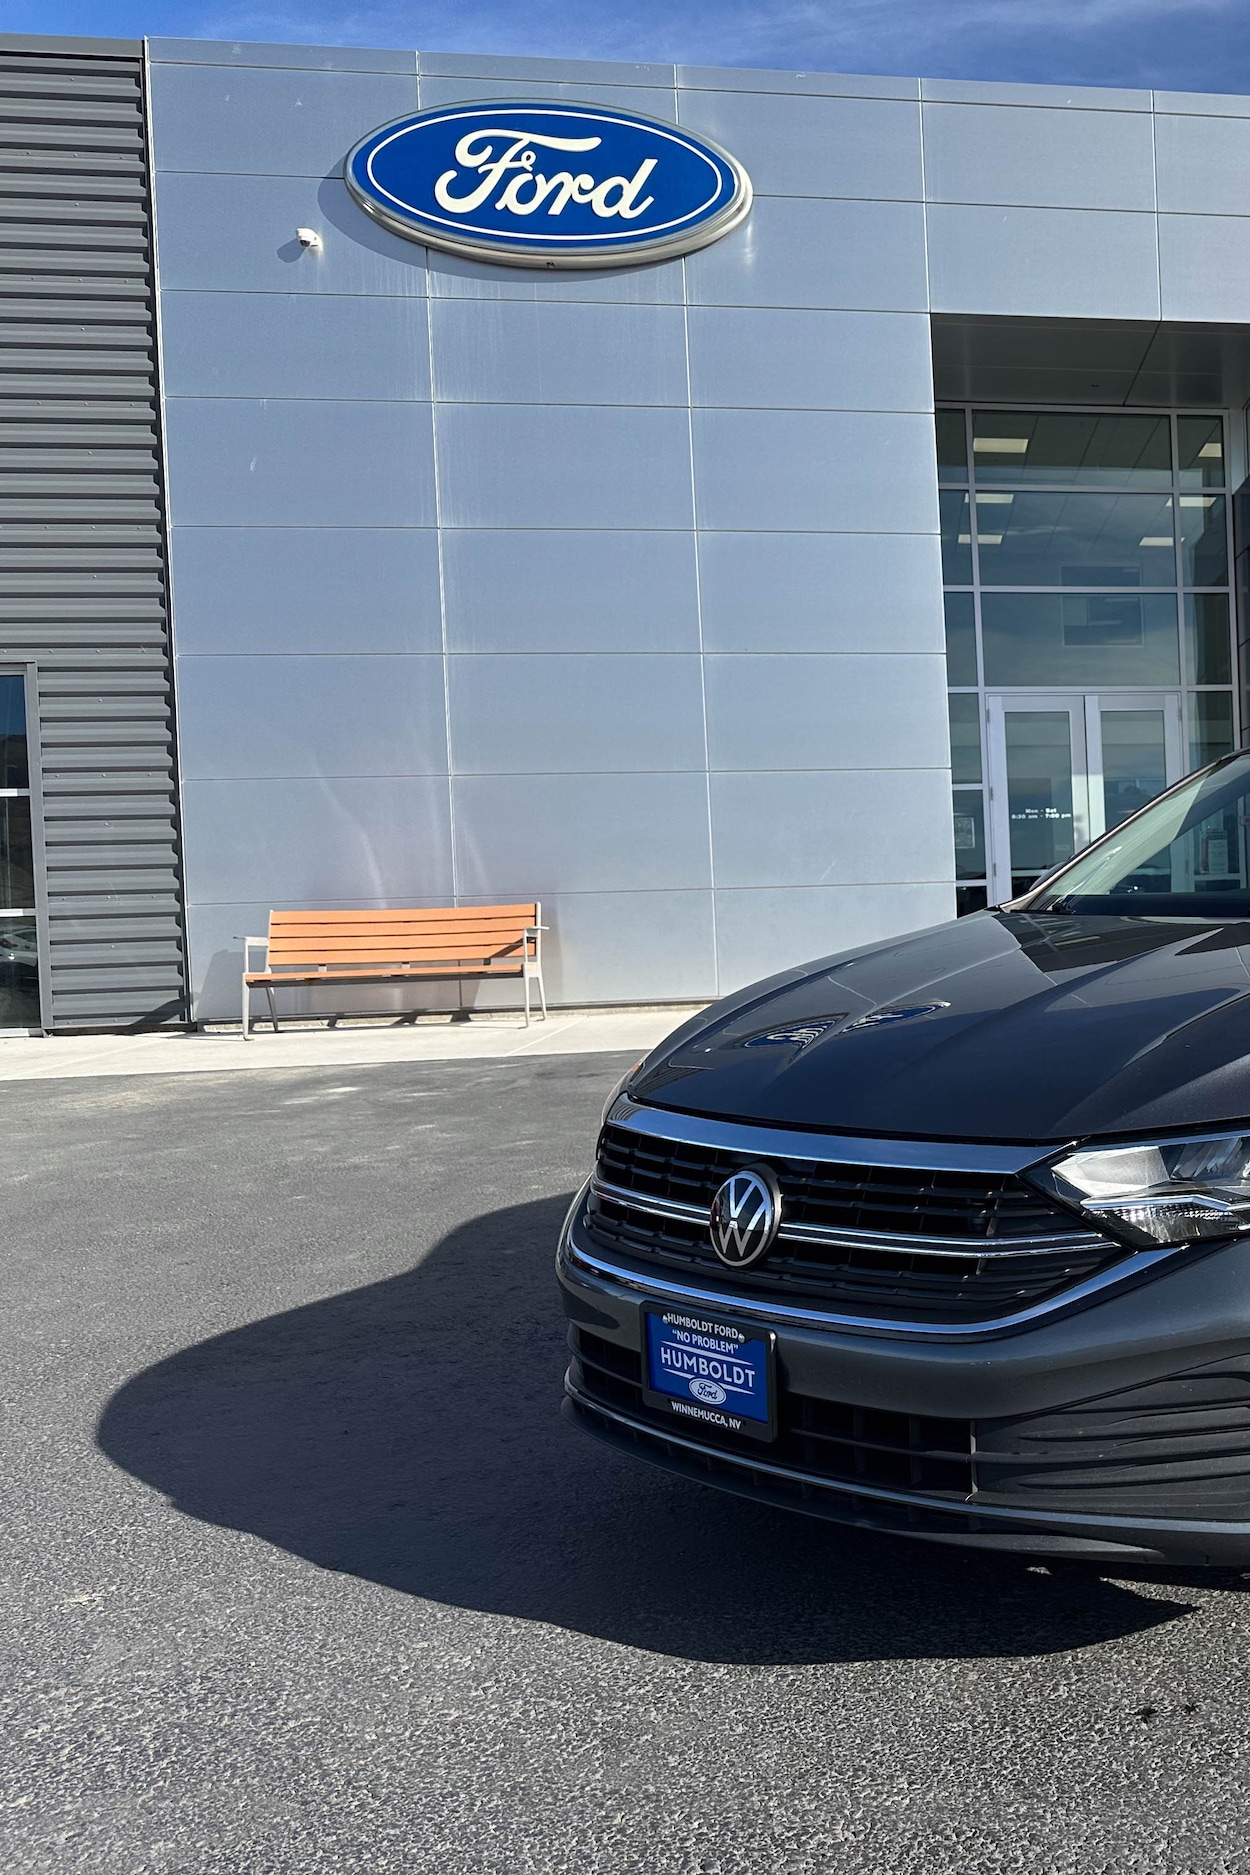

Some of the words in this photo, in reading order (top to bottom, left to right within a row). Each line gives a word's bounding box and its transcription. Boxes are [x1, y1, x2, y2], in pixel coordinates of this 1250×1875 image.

[434, 128, 659, 219] Ford
[667, 1312, 714, 1334] HUMBOLDT
[714, 1322, 739, 1340] FORD
[660, 1346, 756, 1388] HUMBOLDT
[697, 1382, 718, 1401] Ford
[671, 1401, 729, 1428] WINNEMUCCA,
[729, 1417, 742, 1430] NV
